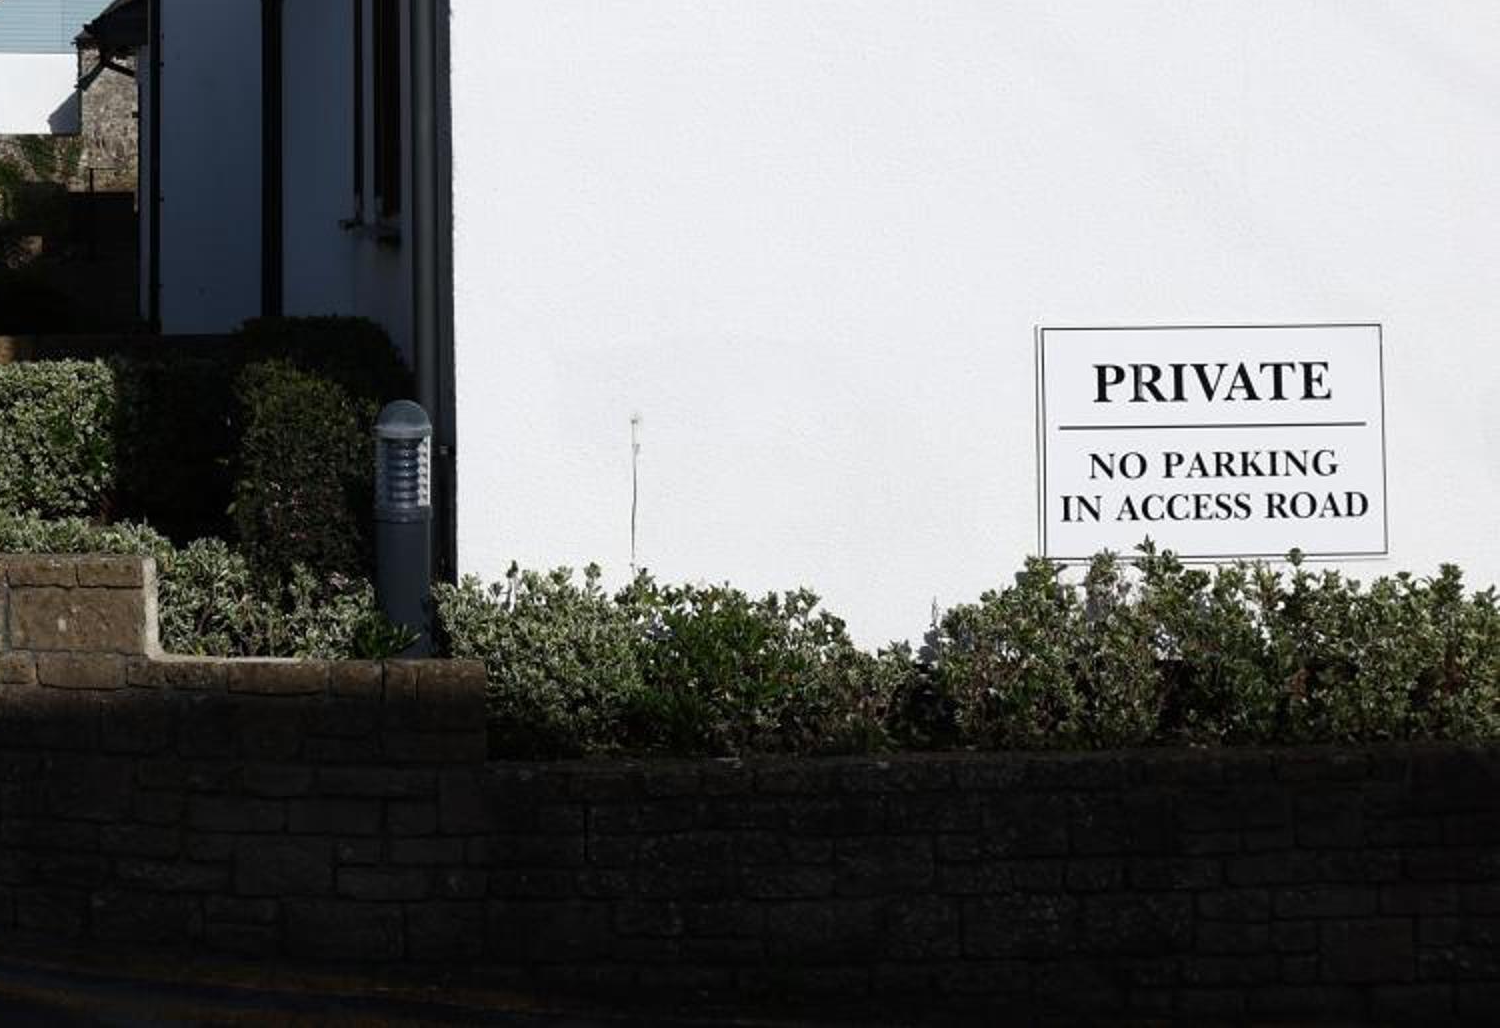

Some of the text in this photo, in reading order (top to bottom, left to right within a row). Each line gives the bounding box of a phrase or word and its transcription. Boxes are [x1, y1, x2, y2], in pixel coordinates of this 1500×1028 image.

[1093, 362, 1331, 403] PRIVATE
[1089, 450, 1338, 479] NO PARKING
[1061, 492, 1368, 522] IN ACCESS ROAD
